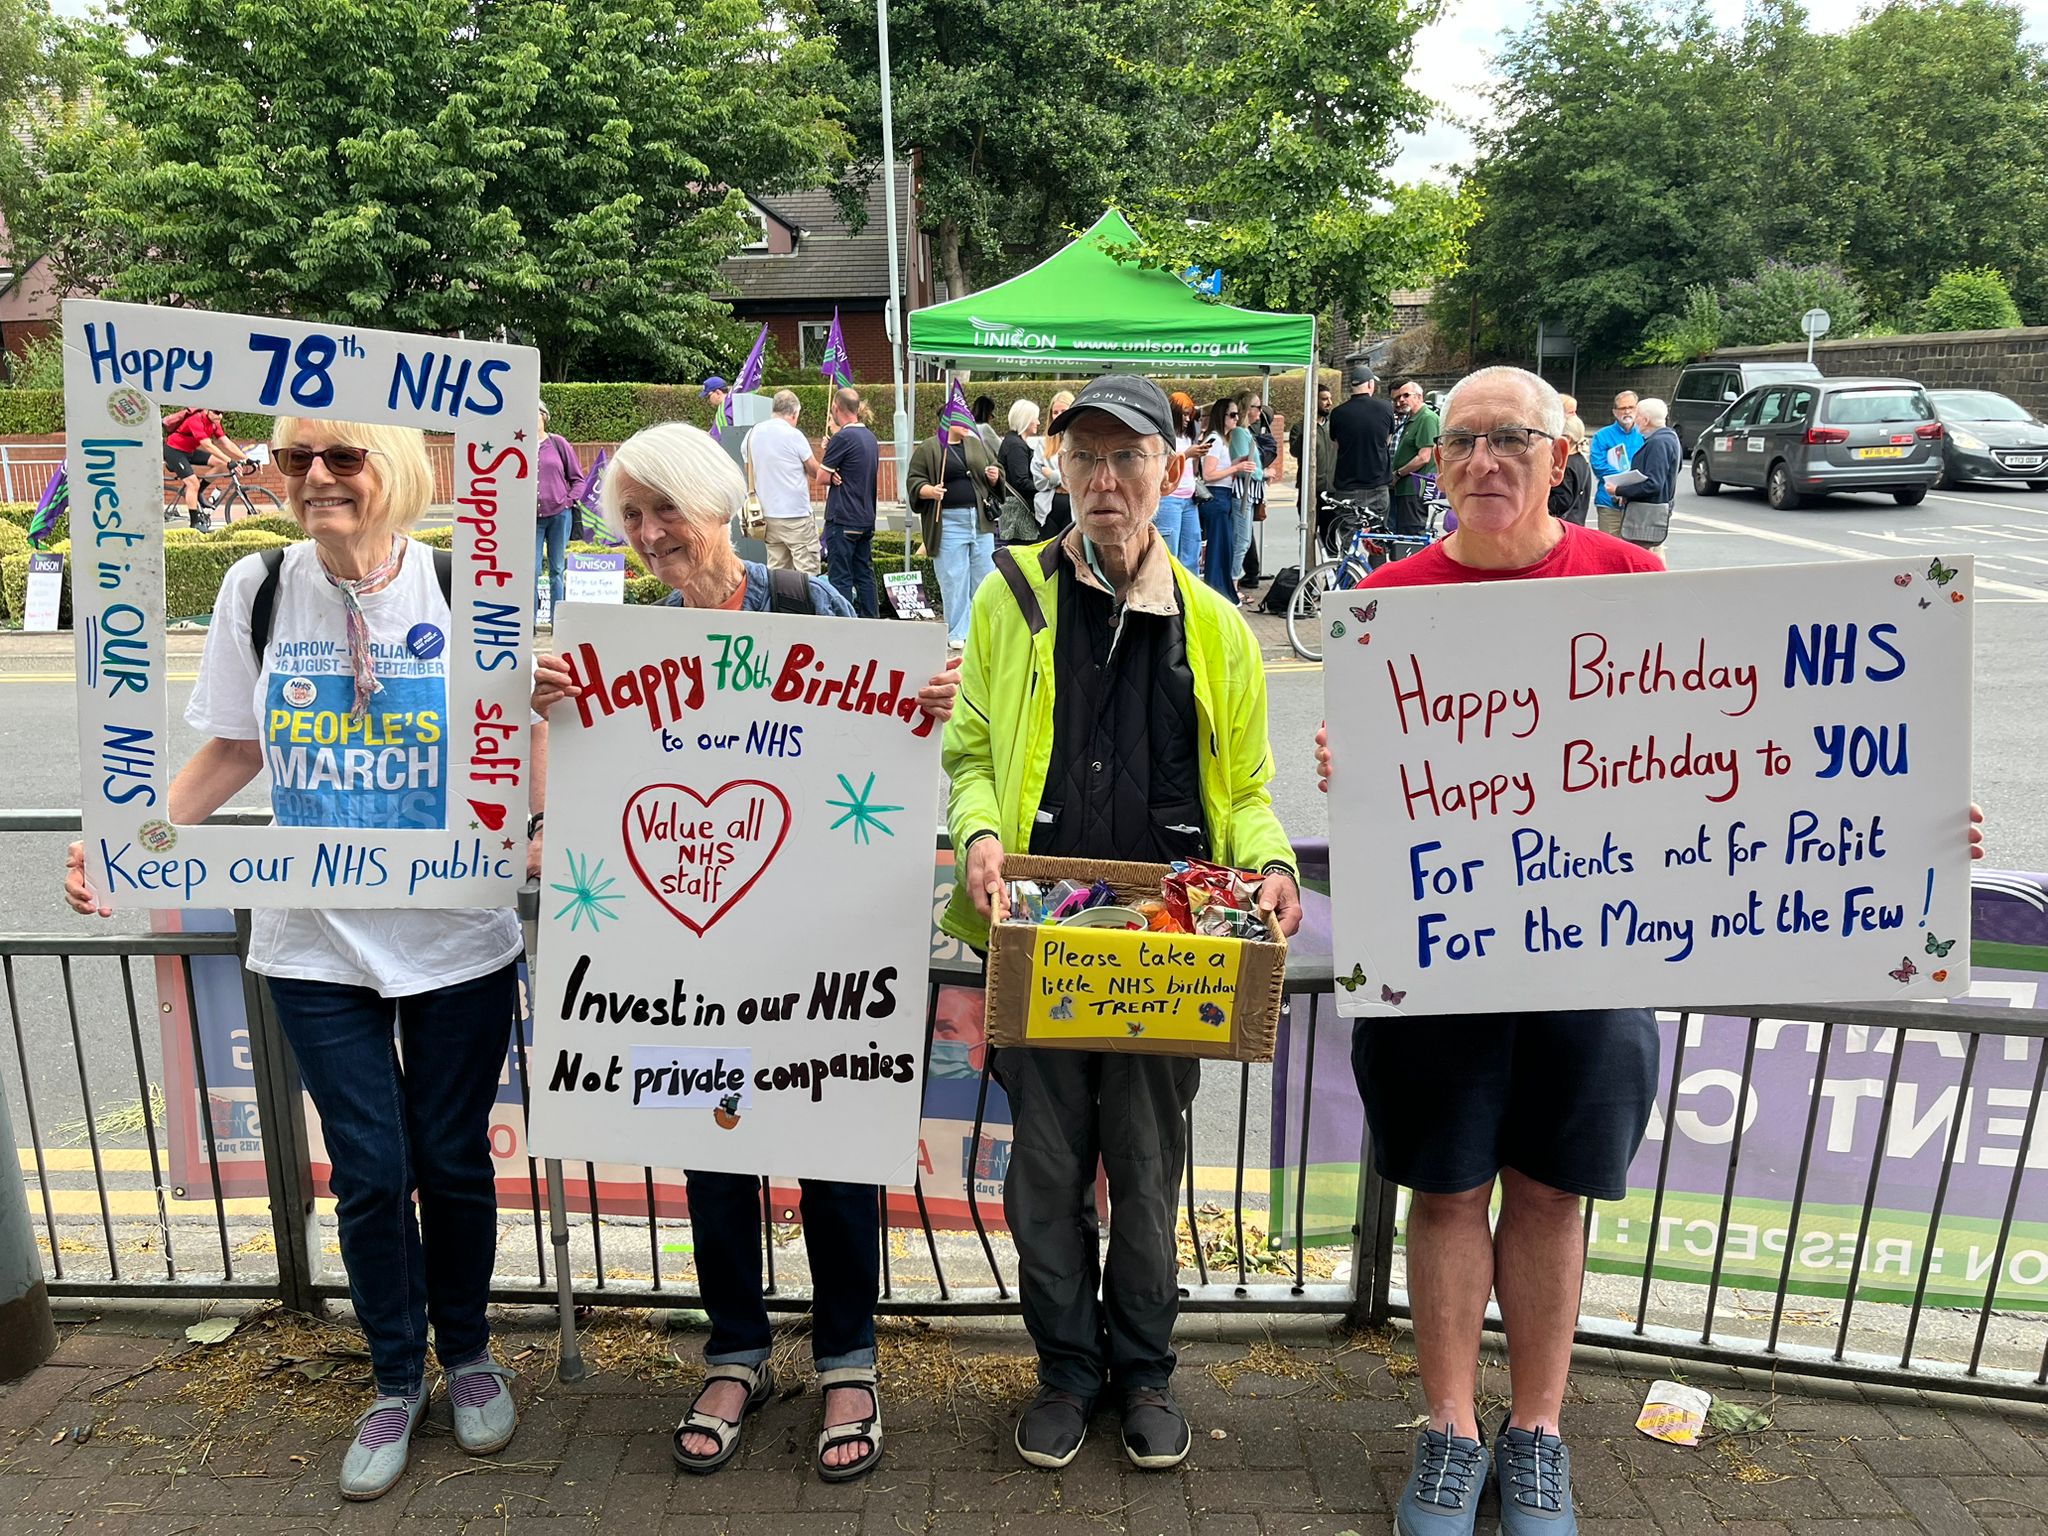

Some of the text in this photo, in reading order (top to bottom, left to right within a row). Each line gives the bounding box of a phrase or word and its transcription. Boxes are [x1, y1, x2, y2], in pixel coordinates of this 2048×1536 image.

[1073, 339, 1249, 356] www.unison.org.uk
[84, 322, 212, 392] Happy
[388, 352, 511, 417] NHS
[35, 561, 59, 571] UNISON
[575, 560, 616, 570] UNISON
[888, 573, 917, 582] UNISON
[891, 585, 918, 596] FAIR
[82, 439, 156, 806] Invest in OUR NHS
[457, 443, 528, 786] Support NHS staff
[290, 681, 312, 691] NHS
[562, 643, 706, 731] Happy
[706, 633, 771, 691] 78th
[1388, 624, 1905, 743] Happy Birthday NHS
[269, 710, 441, 745] PEOPLE'S
[663, 721, 802, 757] to our NHS
[269, 745, 440, 791] MARCH
[1400, 761, 1535, 820] Happy
[1563, 733, 1738, 802] Birthday
[1757, 740, 1790, 776] to
[637, 797, 765, 842] Value all
[101, 839, 513, 900] Keep our NHS public
[679, 842, 734, 865] NHS
[1411, 811, 1885, 900] For Patients not for Profit
[659, 866, 724, 902] staff
[1419, 914, 1495, 968] For
[1526, 907, 1583, 952] the
[1602, 900, 1693, 961] Many
[1712, 892, 1764, 937] not
[1777, 890, 1828, 933] the
[1044, 941, 1225, 967] Please take a
[561, 955, 686, 1026] Invest
[694, 994, 724, 1026] in
[737, 993, 800, 1024] our
[807, 967, 897, 1020] NHS
[1042, 975, 1094, 996] little
[1109, 978, 1155, 995] NHS
[1089, 998, 1181, 1016] TREAT!
[549, 1050, 622, 1092] Not
[633, 1059, 744, 1109] private
